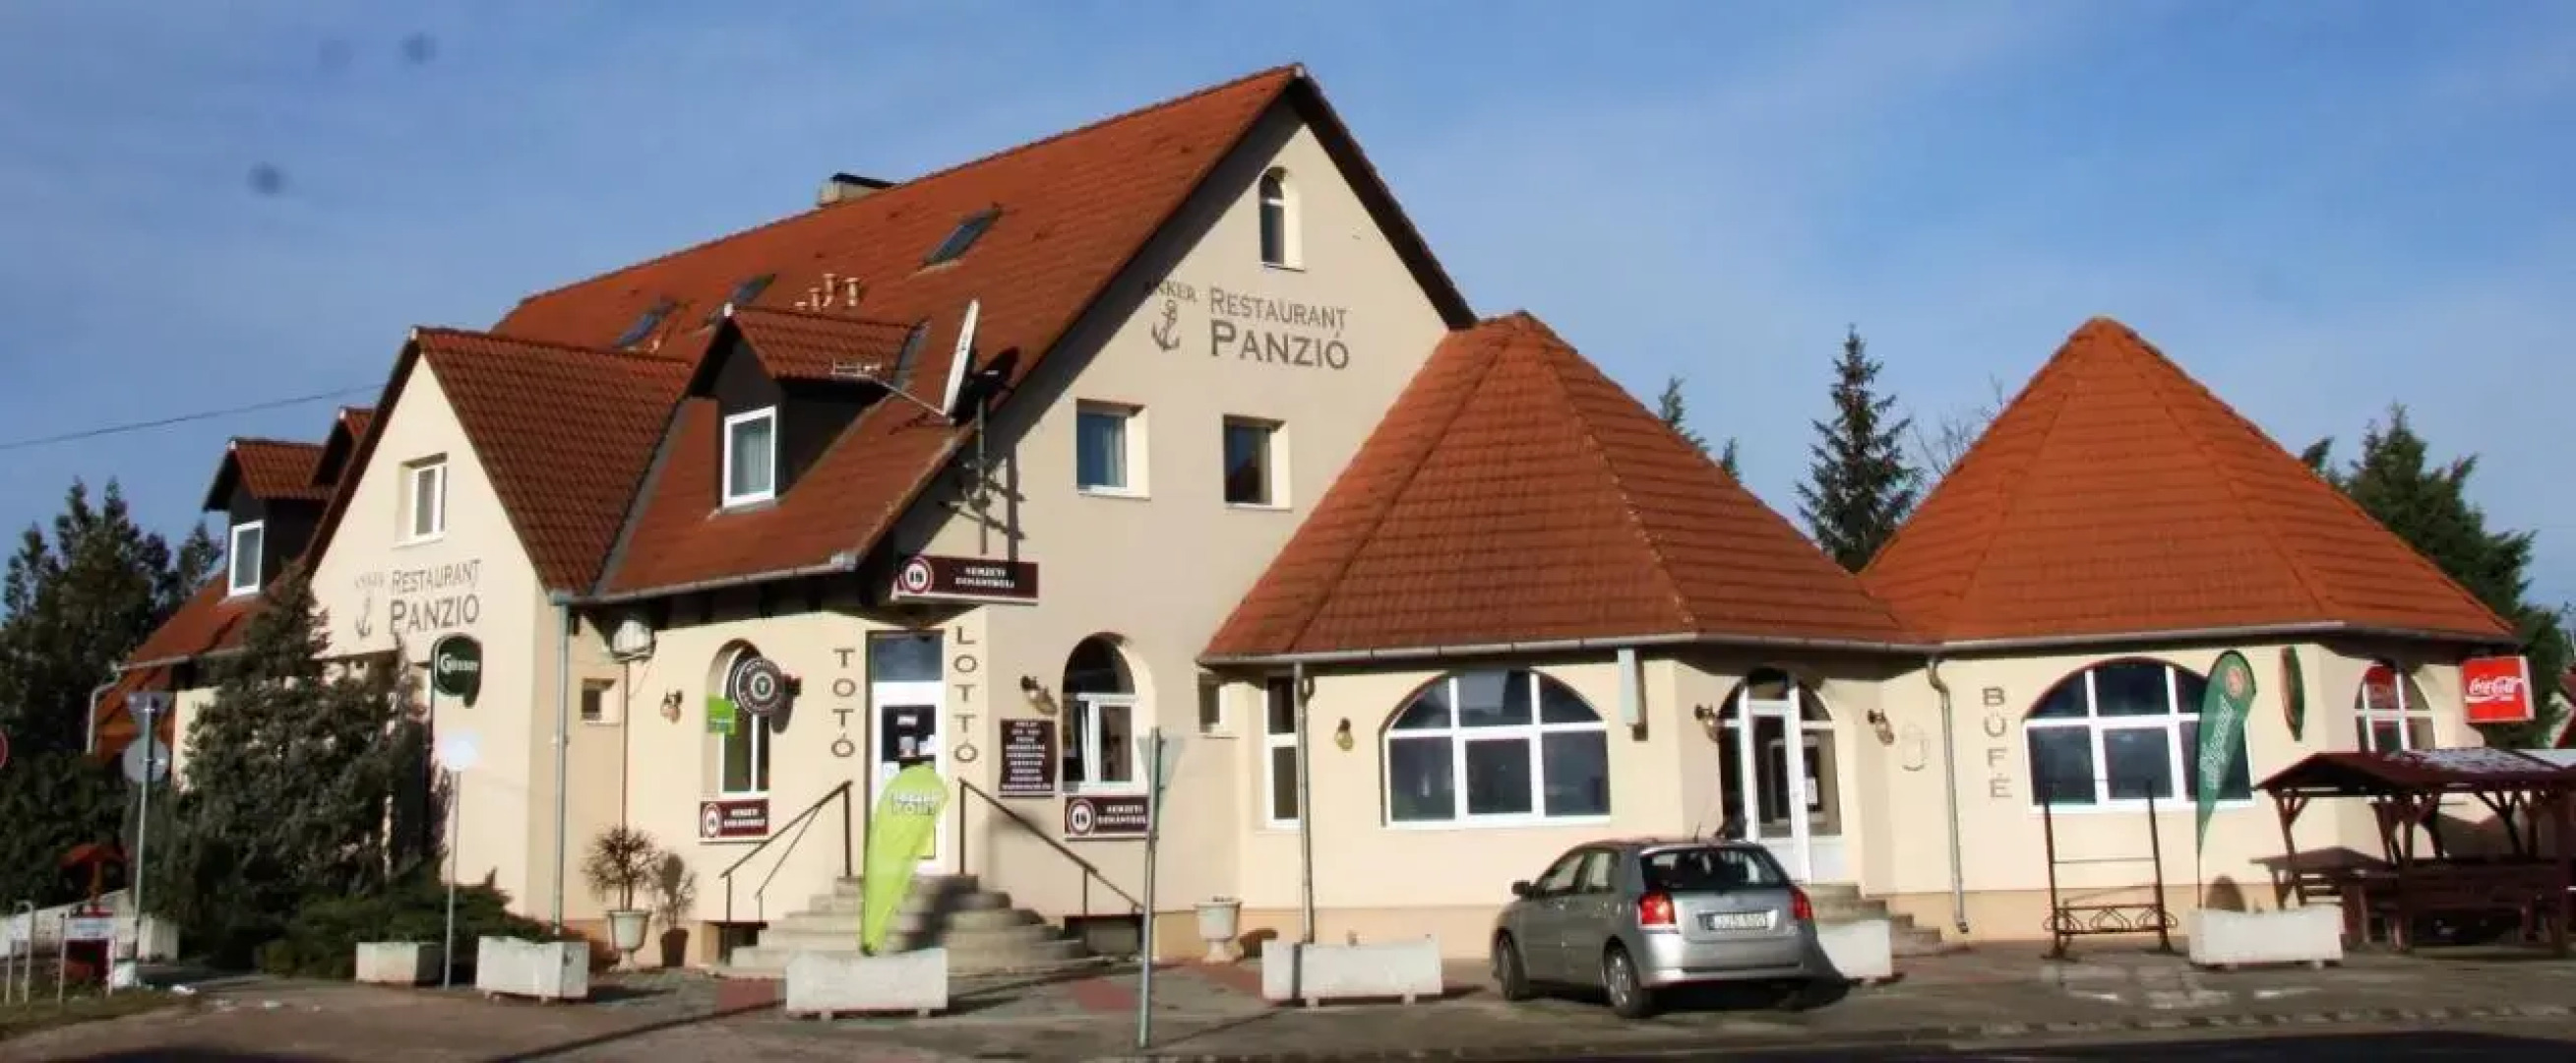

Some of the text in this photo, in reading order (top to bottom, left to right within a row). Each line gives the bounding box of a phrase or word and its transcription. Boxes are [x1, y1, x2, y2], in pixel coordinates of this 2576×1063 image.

[1209, 285, 1349, 331] RESTAURANT
[1210, 318, 1350, 370] PANZIÓ
[392, 557, 480, 594] RESTAURANT
[830, 648, 856, 758] TOTÓ
[953, 626, 978, 763] LOTTÓ
[1982, 686, 2013, 798] BÜFÉ
